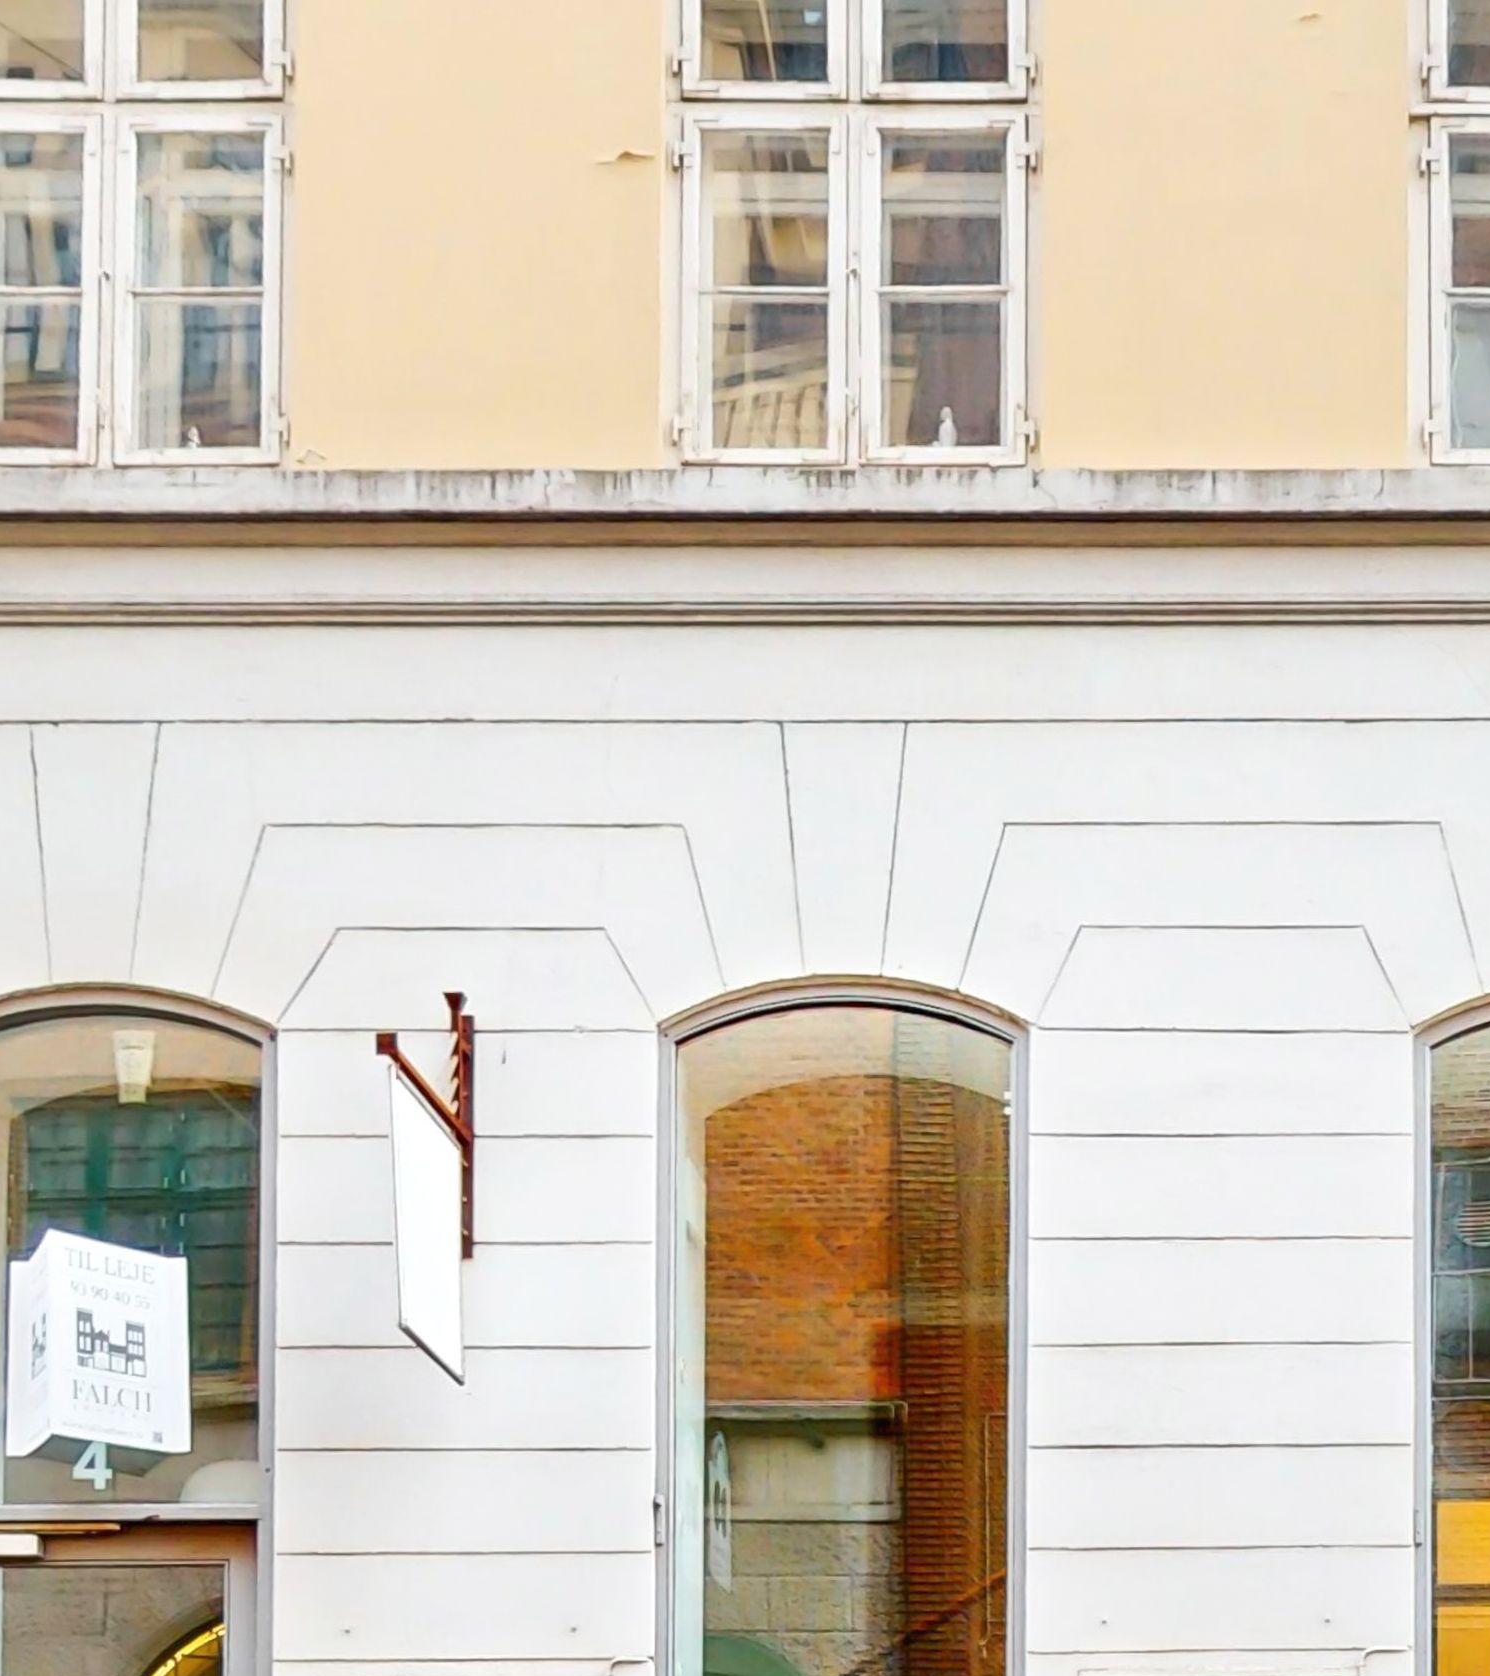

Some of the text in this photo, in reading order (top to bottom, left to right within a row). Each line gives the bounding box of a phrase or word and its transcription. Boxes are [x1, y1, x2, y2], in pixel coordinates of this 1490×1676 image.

[64, 1247, 155, 1285] TIL LEJE
[113, 1291, 131, 1305] 40
[72, 1379, 151, 1413] FALCH
[72, 1440, 113, 1490] 4
